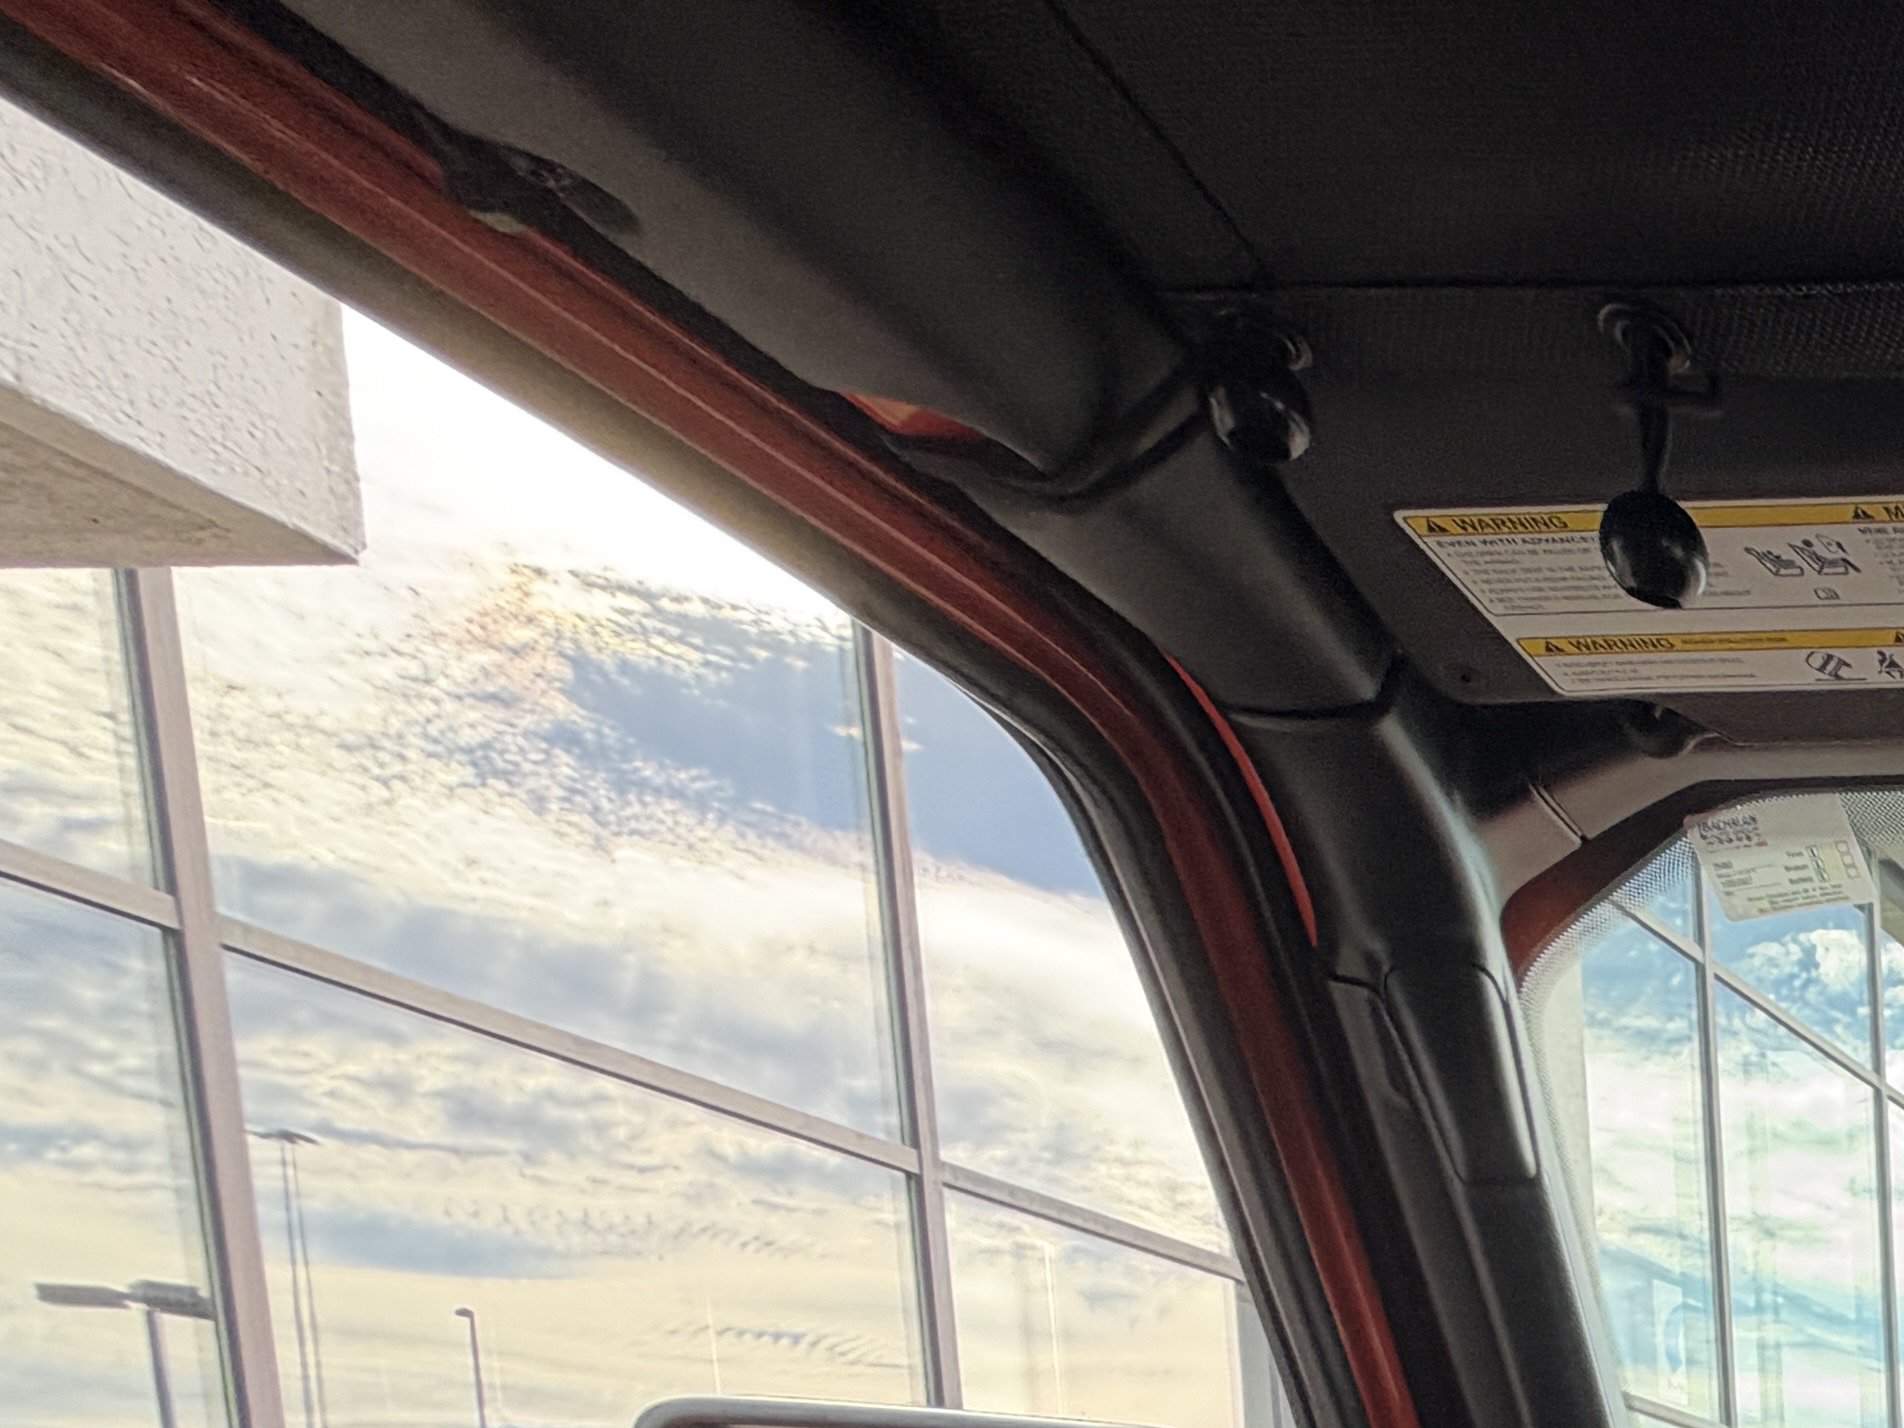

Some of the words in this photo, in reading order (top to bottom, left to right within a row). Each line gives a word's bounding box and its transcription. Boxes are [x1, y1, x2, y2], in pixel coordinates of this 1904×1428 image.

[1452, 515, 1569, 532] WARNING
[1437, 540, 1476, 548] EVEN
[1479, 538, 1517, 547] WITH
[1569, 637, 1674, 652] WARNING
